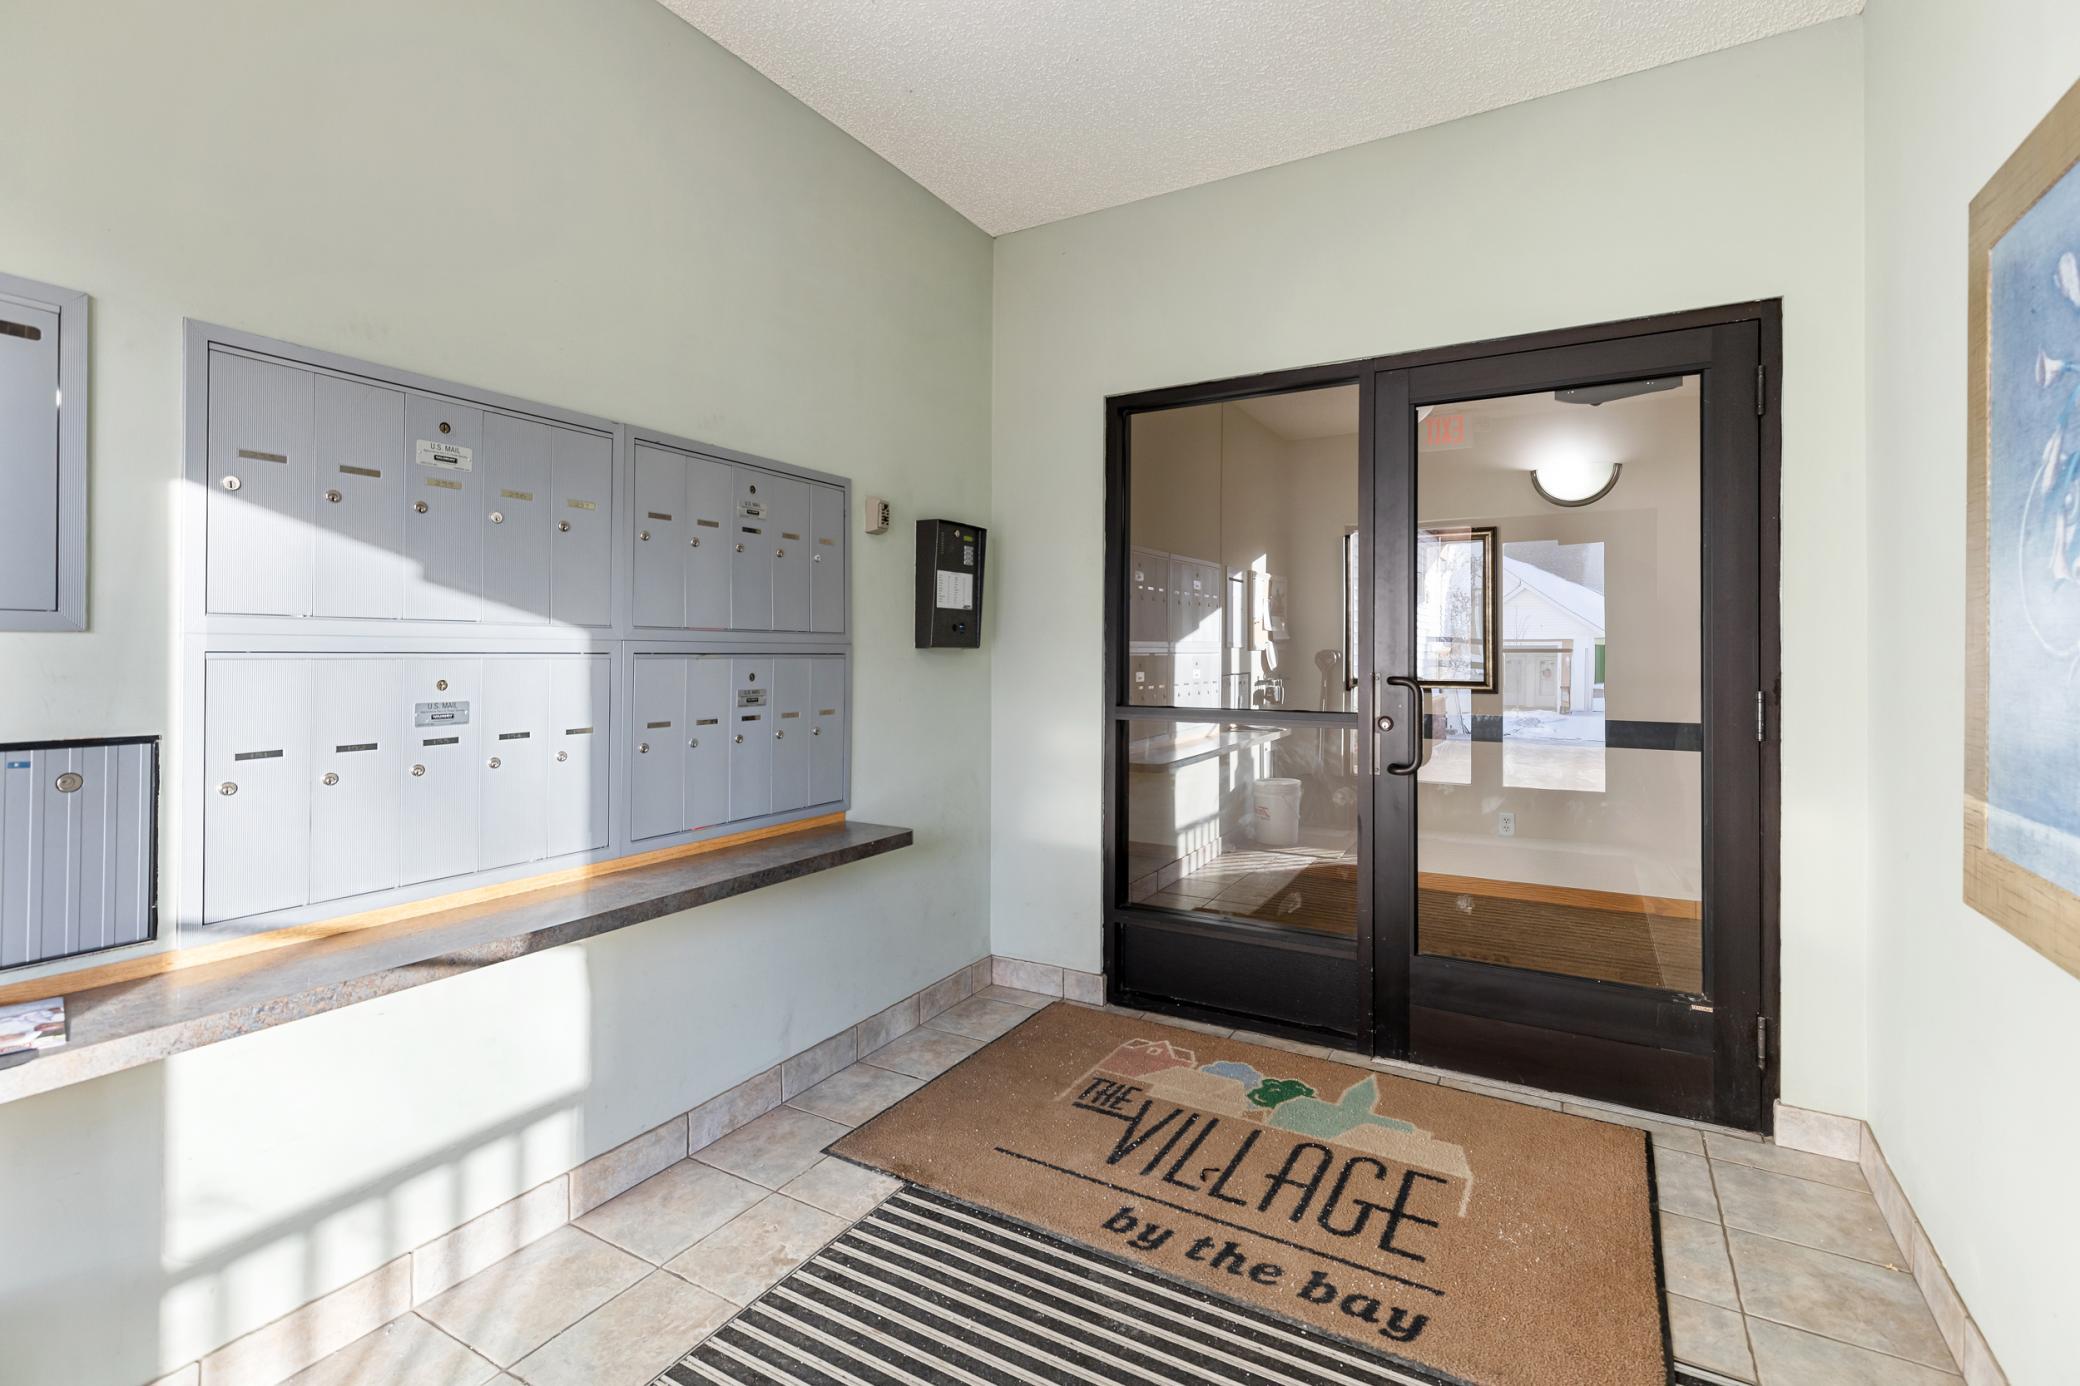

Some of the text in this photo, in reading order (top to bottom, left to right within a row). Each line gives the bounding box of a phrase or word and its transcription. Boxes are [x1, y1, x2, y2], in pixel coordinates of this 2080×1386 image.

[444, 445, 461, 454] MAIL
[1078, 1077, 1143, 1110] THE
[1106, 1100, 1448, 1263] VILLAGE
[1102, 1206, 1430, 1342] by the bay
